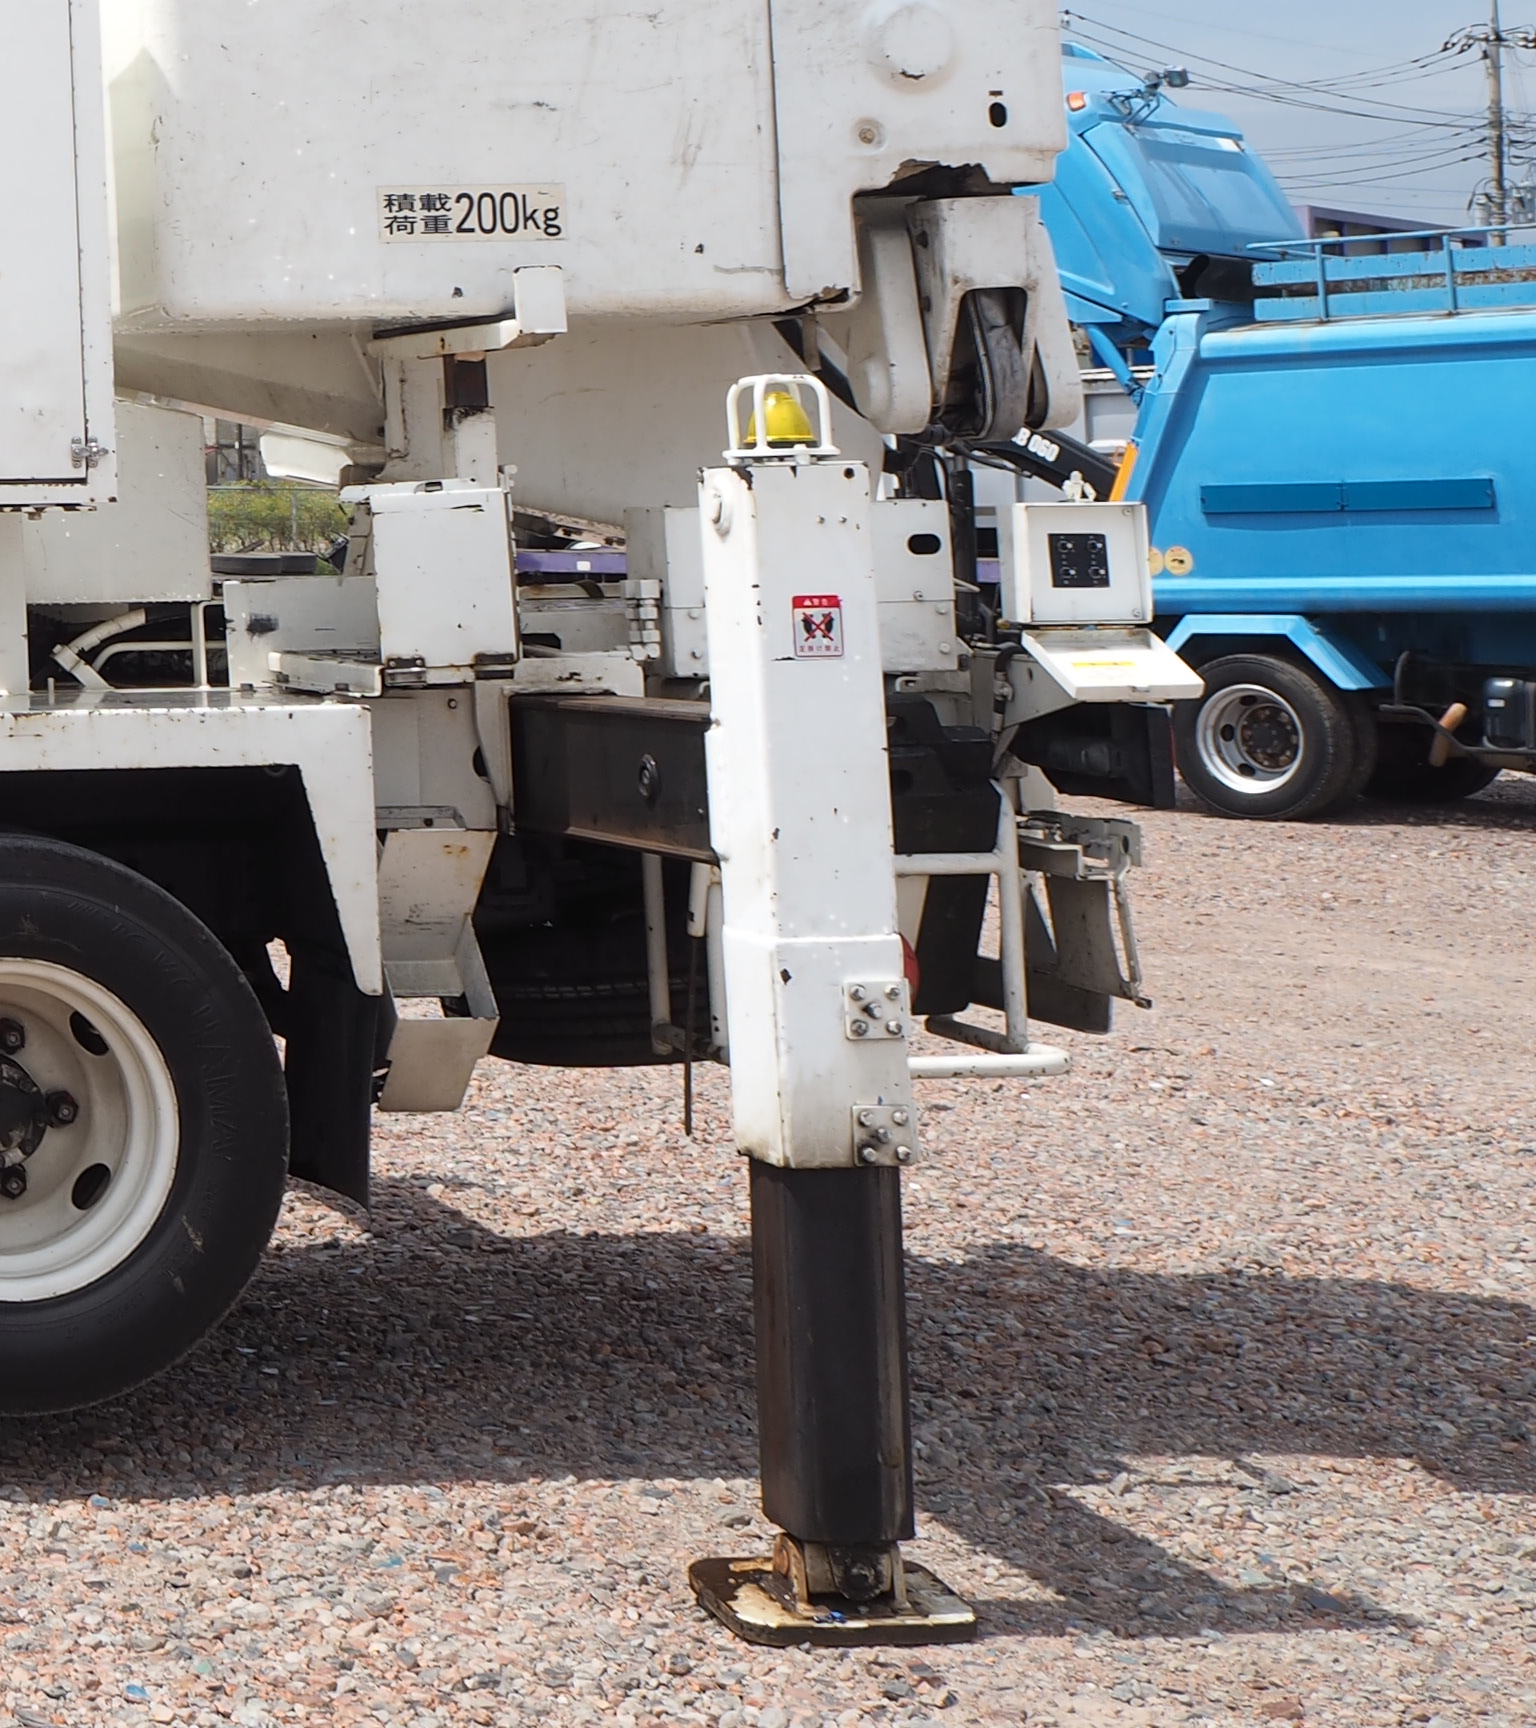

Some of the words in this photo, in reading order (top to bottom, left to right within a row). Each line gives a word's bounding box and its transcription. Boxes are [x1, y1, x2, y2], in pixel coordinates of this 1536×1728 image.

[384, 193, 452, 213] 積載
[454, 192, 562, 236] 200kg
[384, 215, 453, 235] 荷重
[1011, 426, 1031, 447] B
